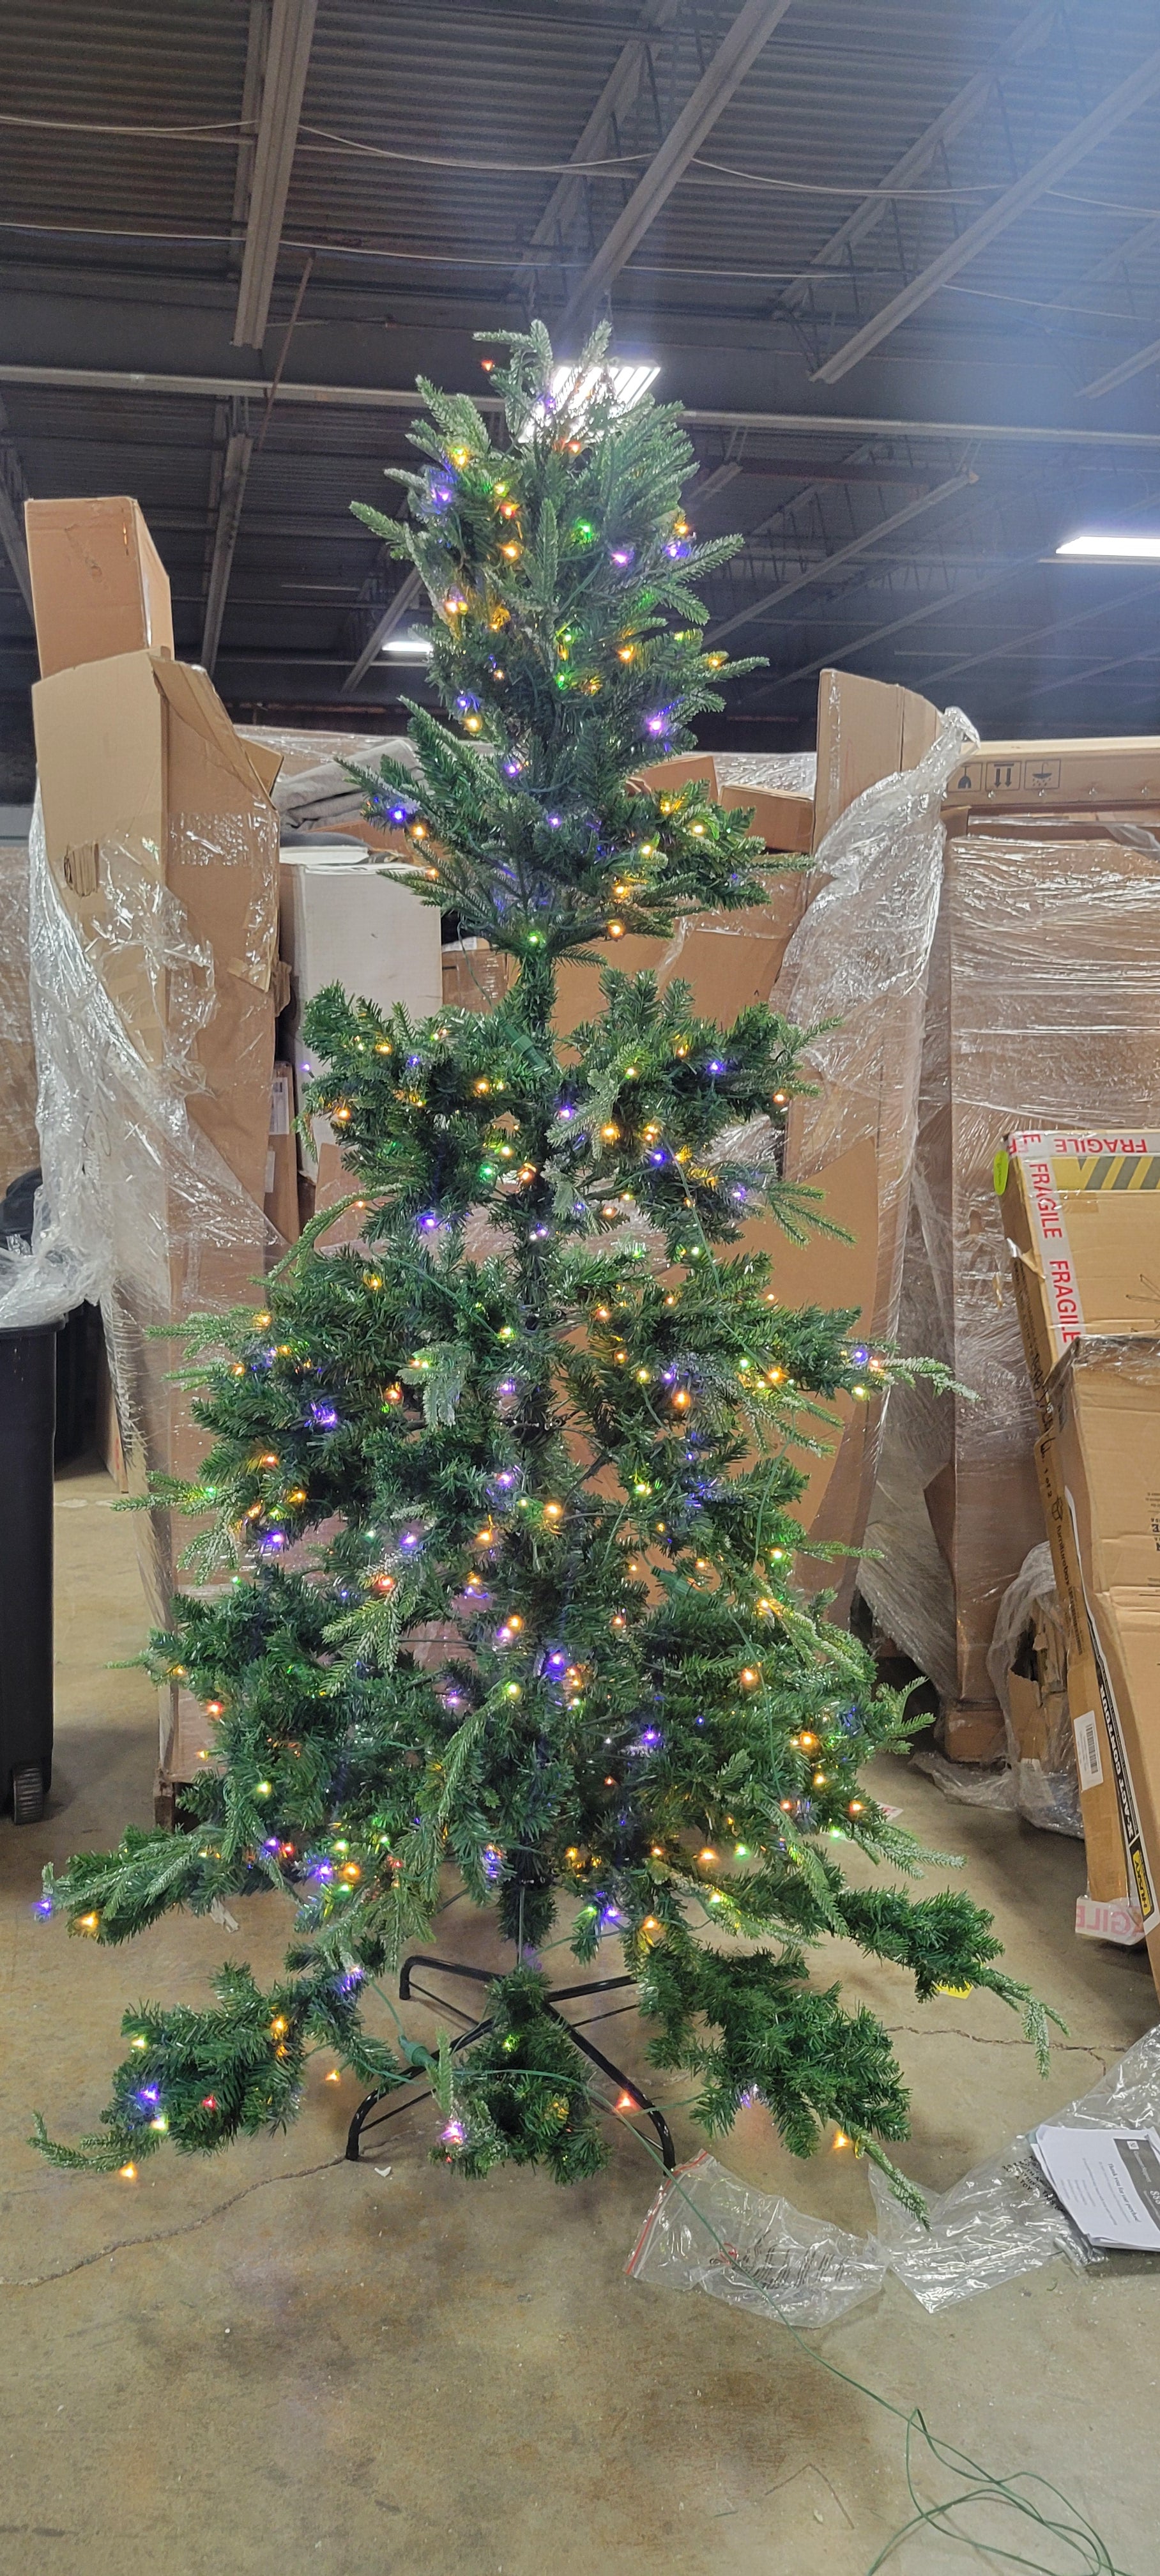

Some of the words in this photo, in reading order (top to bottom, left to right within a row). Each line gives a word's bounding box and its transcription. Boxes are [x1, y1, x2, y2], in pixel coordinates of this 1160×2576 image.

[1053, 1138, 1148, 1154] FRAGILE
[1029, 1163, 1063, 1239] FRAGILE
[1049, 1261, 1081, 1344] FRAGILE
[1056, 1524, 1071, 1585] furniturebox
[1100, 1684, 1122, 1776] CONTOUR
